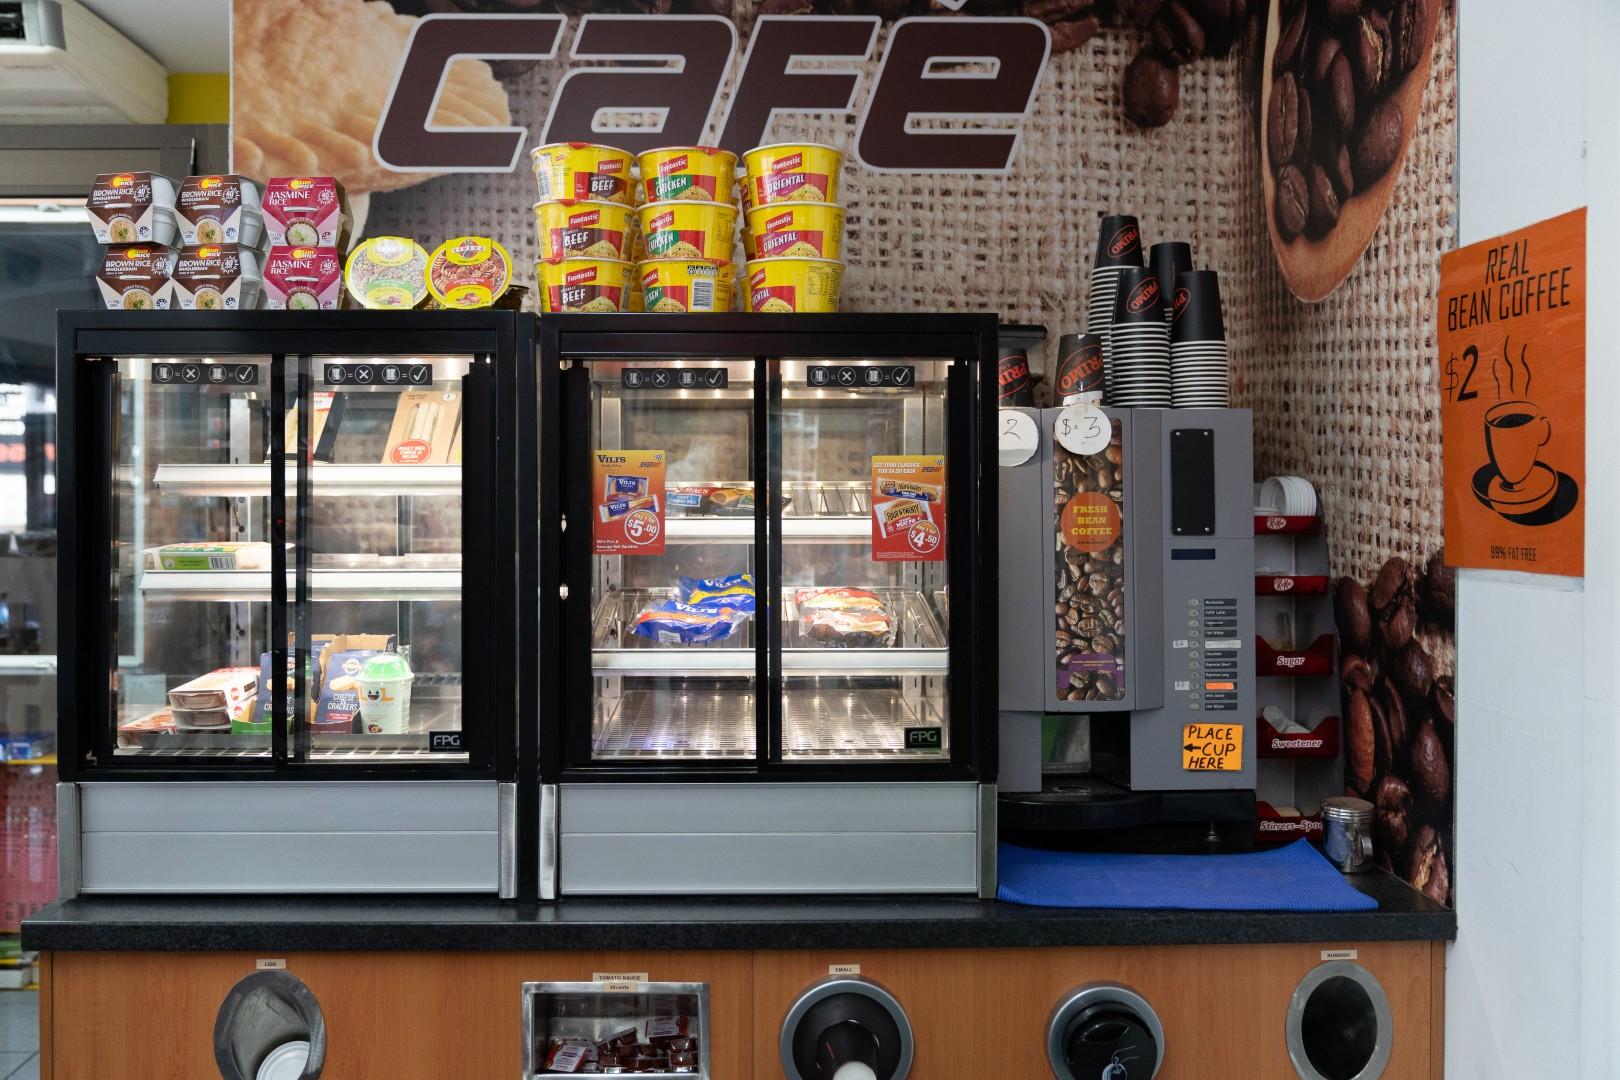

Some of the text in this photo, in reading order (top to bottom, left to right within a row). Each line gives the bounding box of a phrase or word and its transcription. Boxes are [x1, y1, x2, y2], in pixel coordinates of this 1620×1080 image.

[599, 162, 623, 171] Fantastic
[660, 158, 687, 173] Fantastic
[773, 156, 801, 170] Fantastic
[591, 180, 614, 192] BEEF
[656, 177, 687, 196] CHICKEN
[767, 174, 805, 193] ORIENTAL
[92, 188, 120, 196] BROWN
[182, 190, 206, 198] BROWN
[270, 190, 311, 198] JASMINE
[570, 213, 598, 225] Fantastic
[766, 215, 792, 229] Fantastic
[564, 232, 588, 247] BEEF
[763, 232, 798, 252] ORIENTAL
[272, 260, 312, 268] JASMINE
[1485, 238, 1530, 285] REAL
[567, 270, 596, 282] Fantastic
[562, 288, 586, 304] BEEF
[1130, 280, 1159, 310] PRIMO
[1448, 266, 1572, 332] BEAN COFFEE
[1444, 344, 1479, 403] $2
[1003, 418, 1022, 440] 2
[628, 519, 657, 536] $5.00
[910, 531, 937, 547] $4.50
[1490, 545, 1537, 562] 99% FAT FREE
[1276, 656, 1306, 668] Sugar
[328, 702, 358, 711] CRACKERS
[910, 731, 937, 742] FPG
[1188, 725, 1232, 740] PLACE
[433, 735, 460, 746] FPG
[1272, 739, 1322, 749] Sweetener
[1202, 742, 1236, 756] CUP
[1188, 756, 1224, 770] HERE
